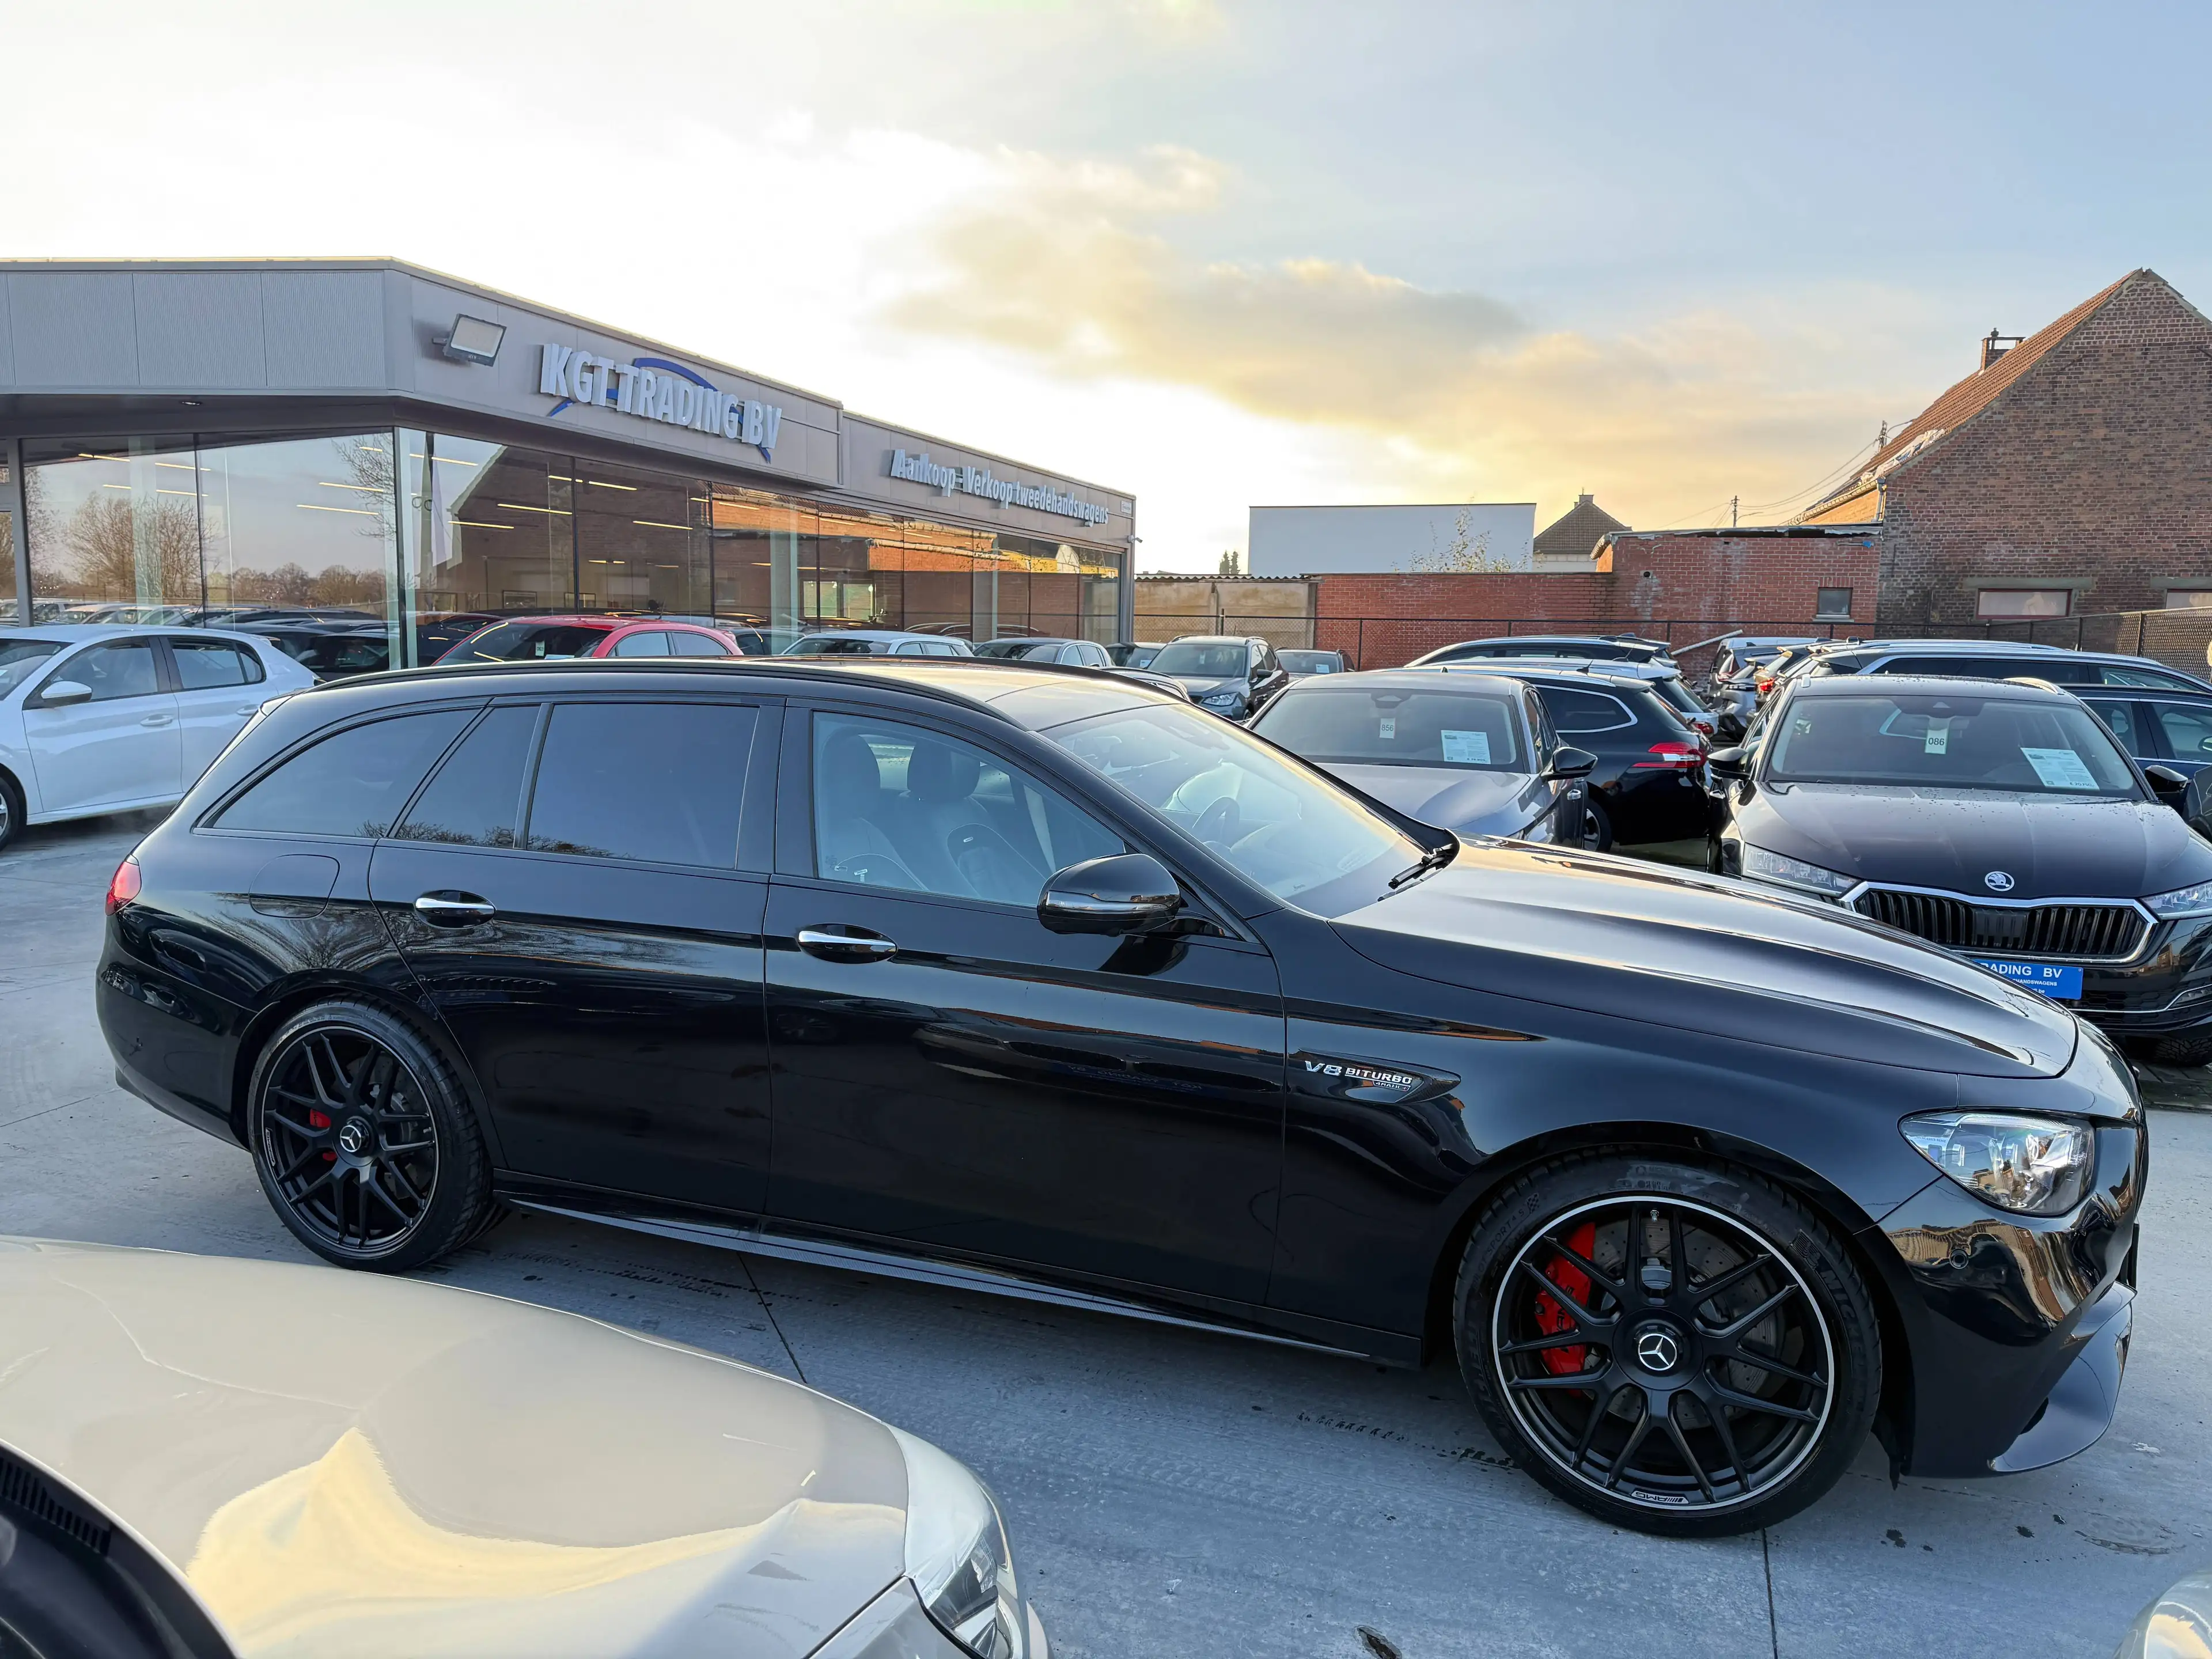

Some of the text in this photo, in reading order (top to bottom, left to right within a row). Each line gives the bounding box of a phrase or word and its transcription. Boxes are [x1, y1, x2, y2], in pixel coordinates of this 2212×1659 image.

[540, 343, 782, 449] KGT TRADING BV
[891, 448, 956, 498] Aankoop
[963, 465, 1013, 510] Verkoop
[1015, 480, 1109, 527] tweedehandswagens
[1381, 724, 1394, 732] 856
[1928, 737, 1945, 746] 086
[1980, 962, 2063, 979] ADING BV
[2013, 978, 2058, 987] HANDSWAGENS
[1304, 1060, 1413, 1085] V8 BITURBO
[1487, 1220, 1512, 1256] SPORT
[1635, 1491, 1668, 1502] AMG
